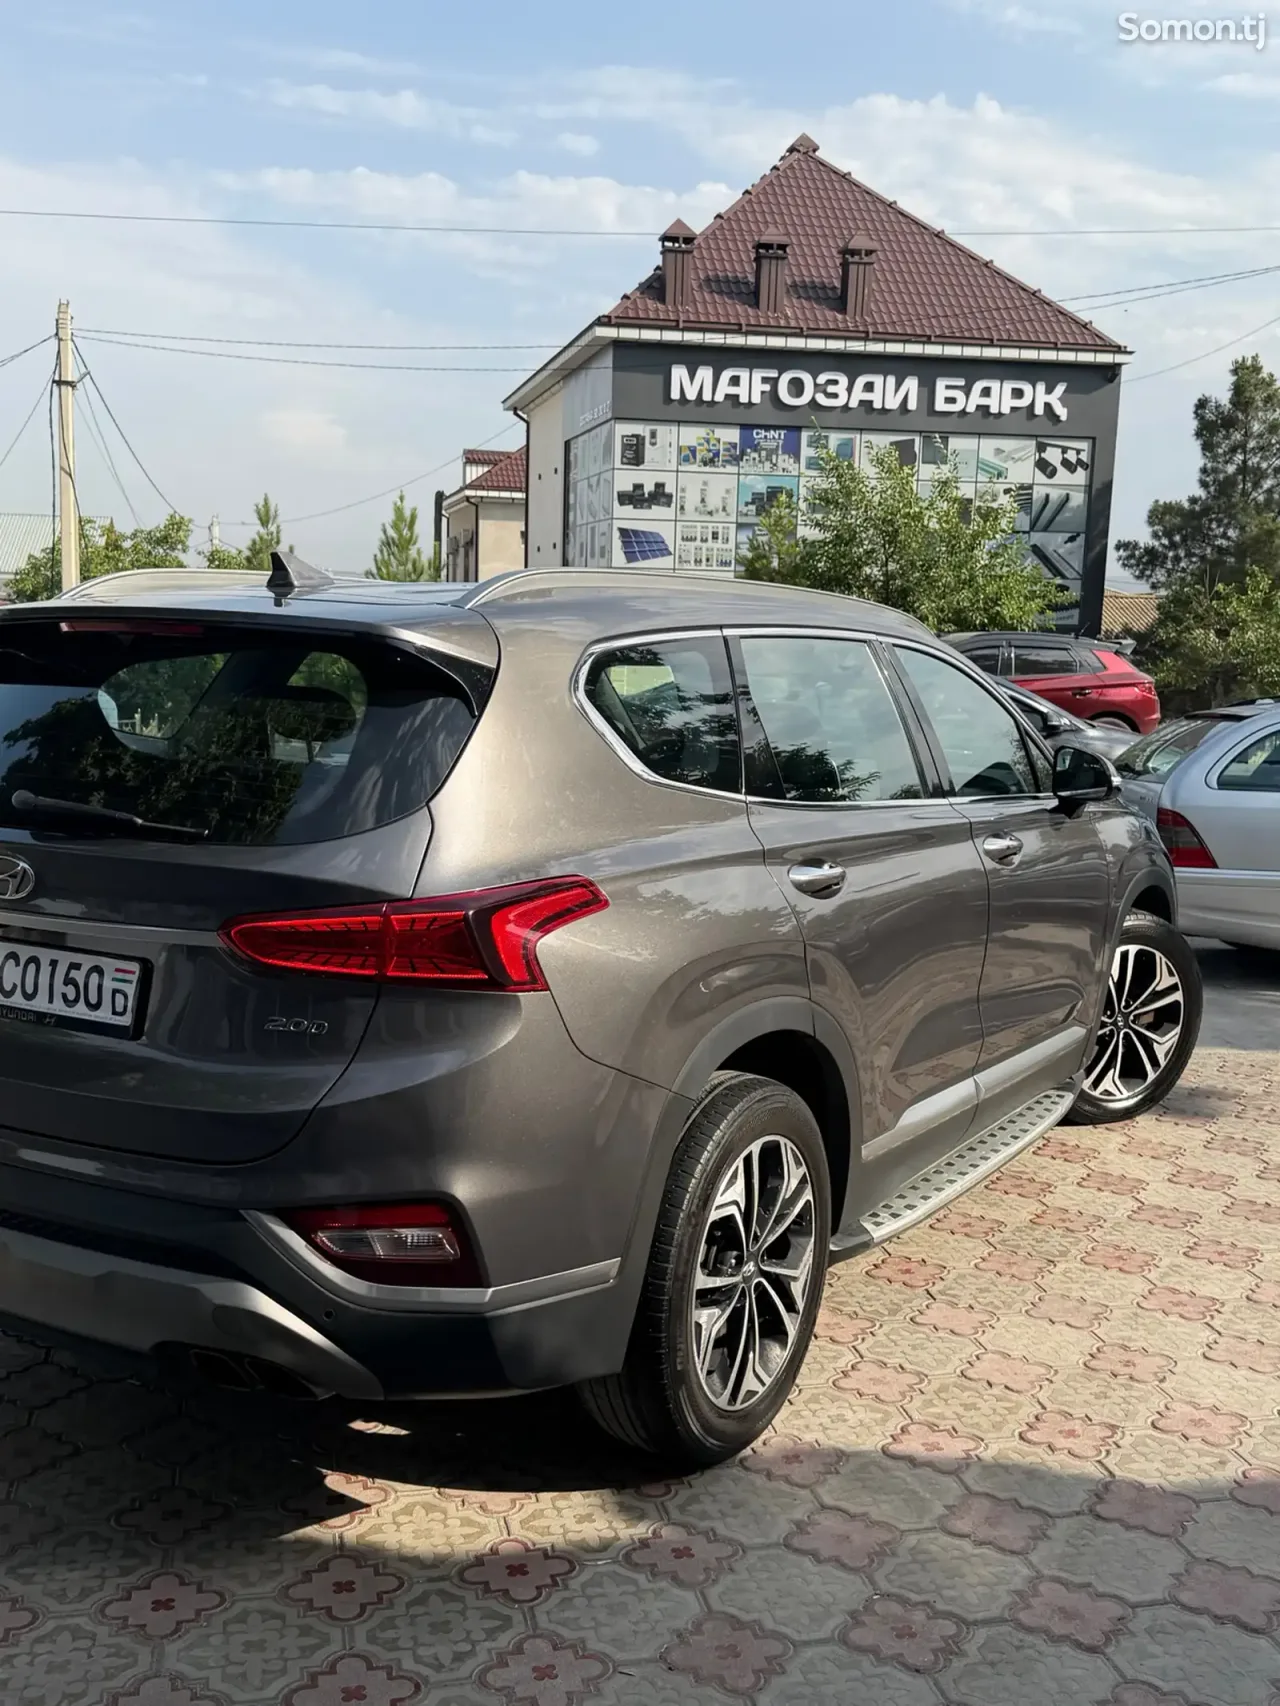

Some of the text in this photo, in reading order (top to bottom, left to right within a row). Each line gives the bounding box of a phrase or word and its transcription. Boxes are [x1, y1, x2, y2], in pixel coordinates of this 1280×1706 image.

[934, 377, 1068, 421] БАРҚ
[0, 1006, 37, 1023] YUNDAI
[111, 988, 129, 1017] D
